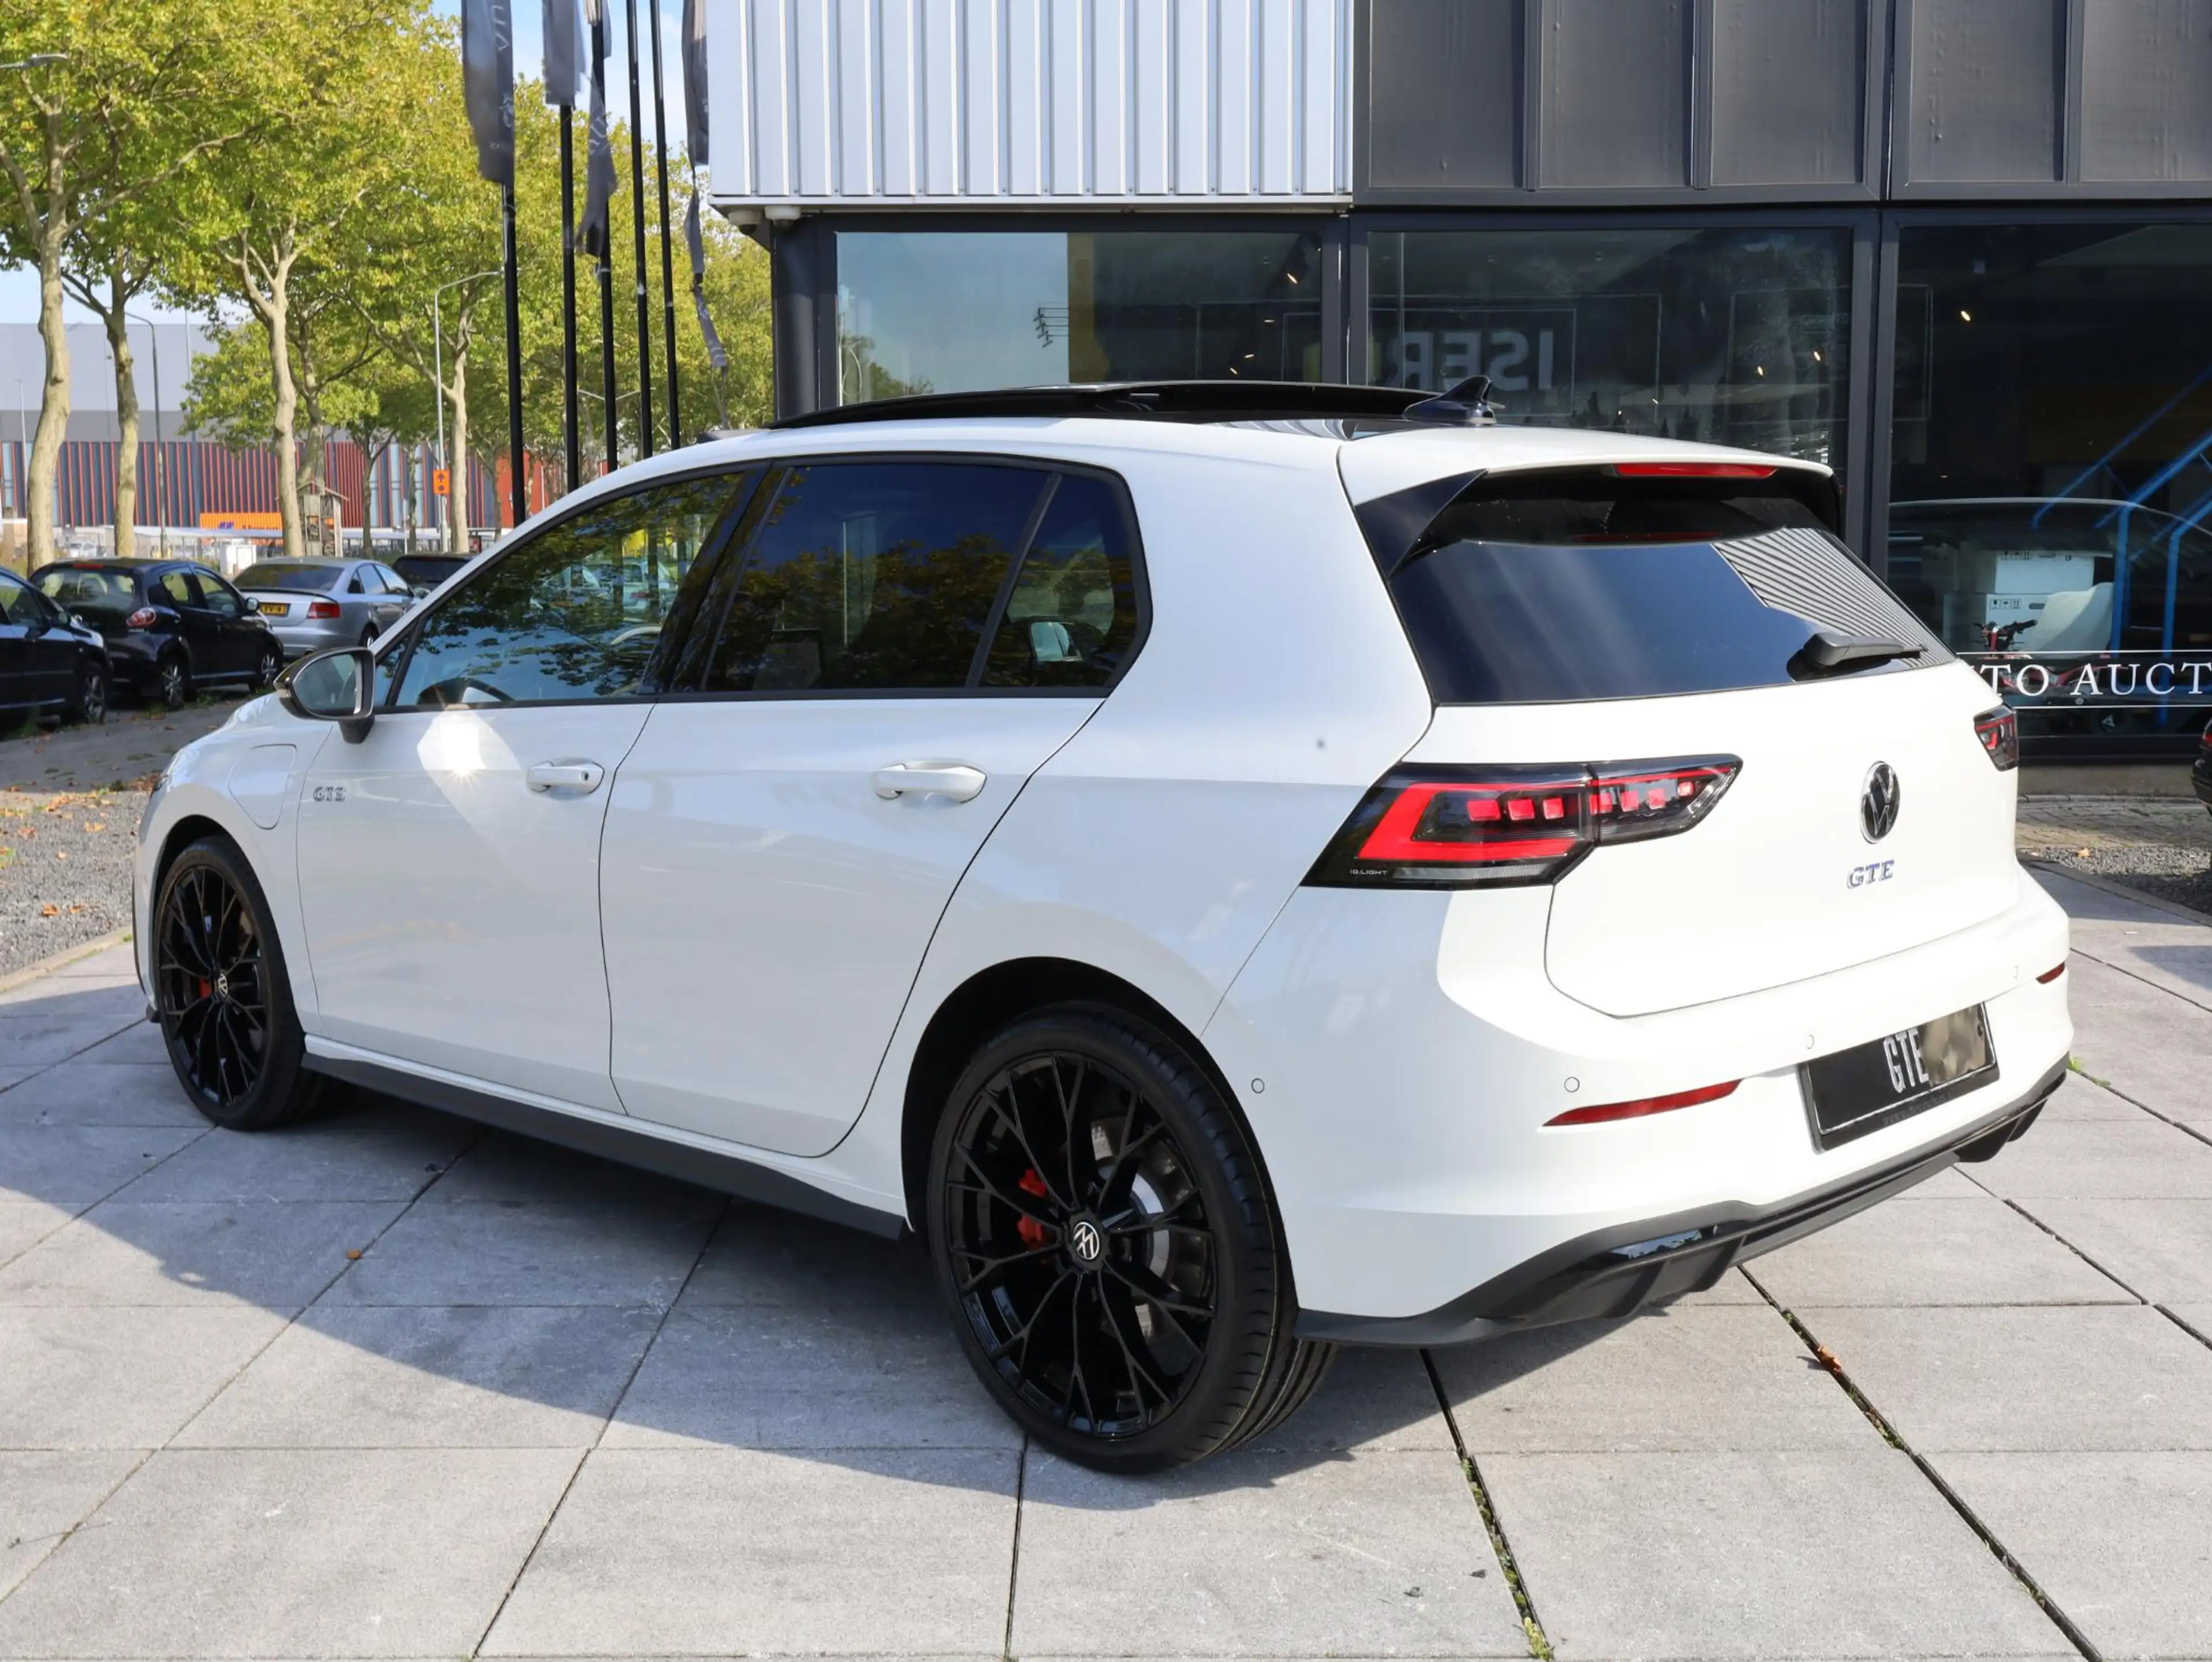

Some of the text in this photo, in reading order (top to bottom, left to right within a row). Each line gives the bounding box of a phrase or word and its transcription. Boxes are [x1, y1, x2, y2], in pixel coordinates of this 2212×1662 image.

[1970, 662, 2212, 697] TO AUCT
[313, 786, 346, 802] GTE
[1847, 859, 1895, 889] GTE
[1883, 1027, 1929, 1094] GTE
